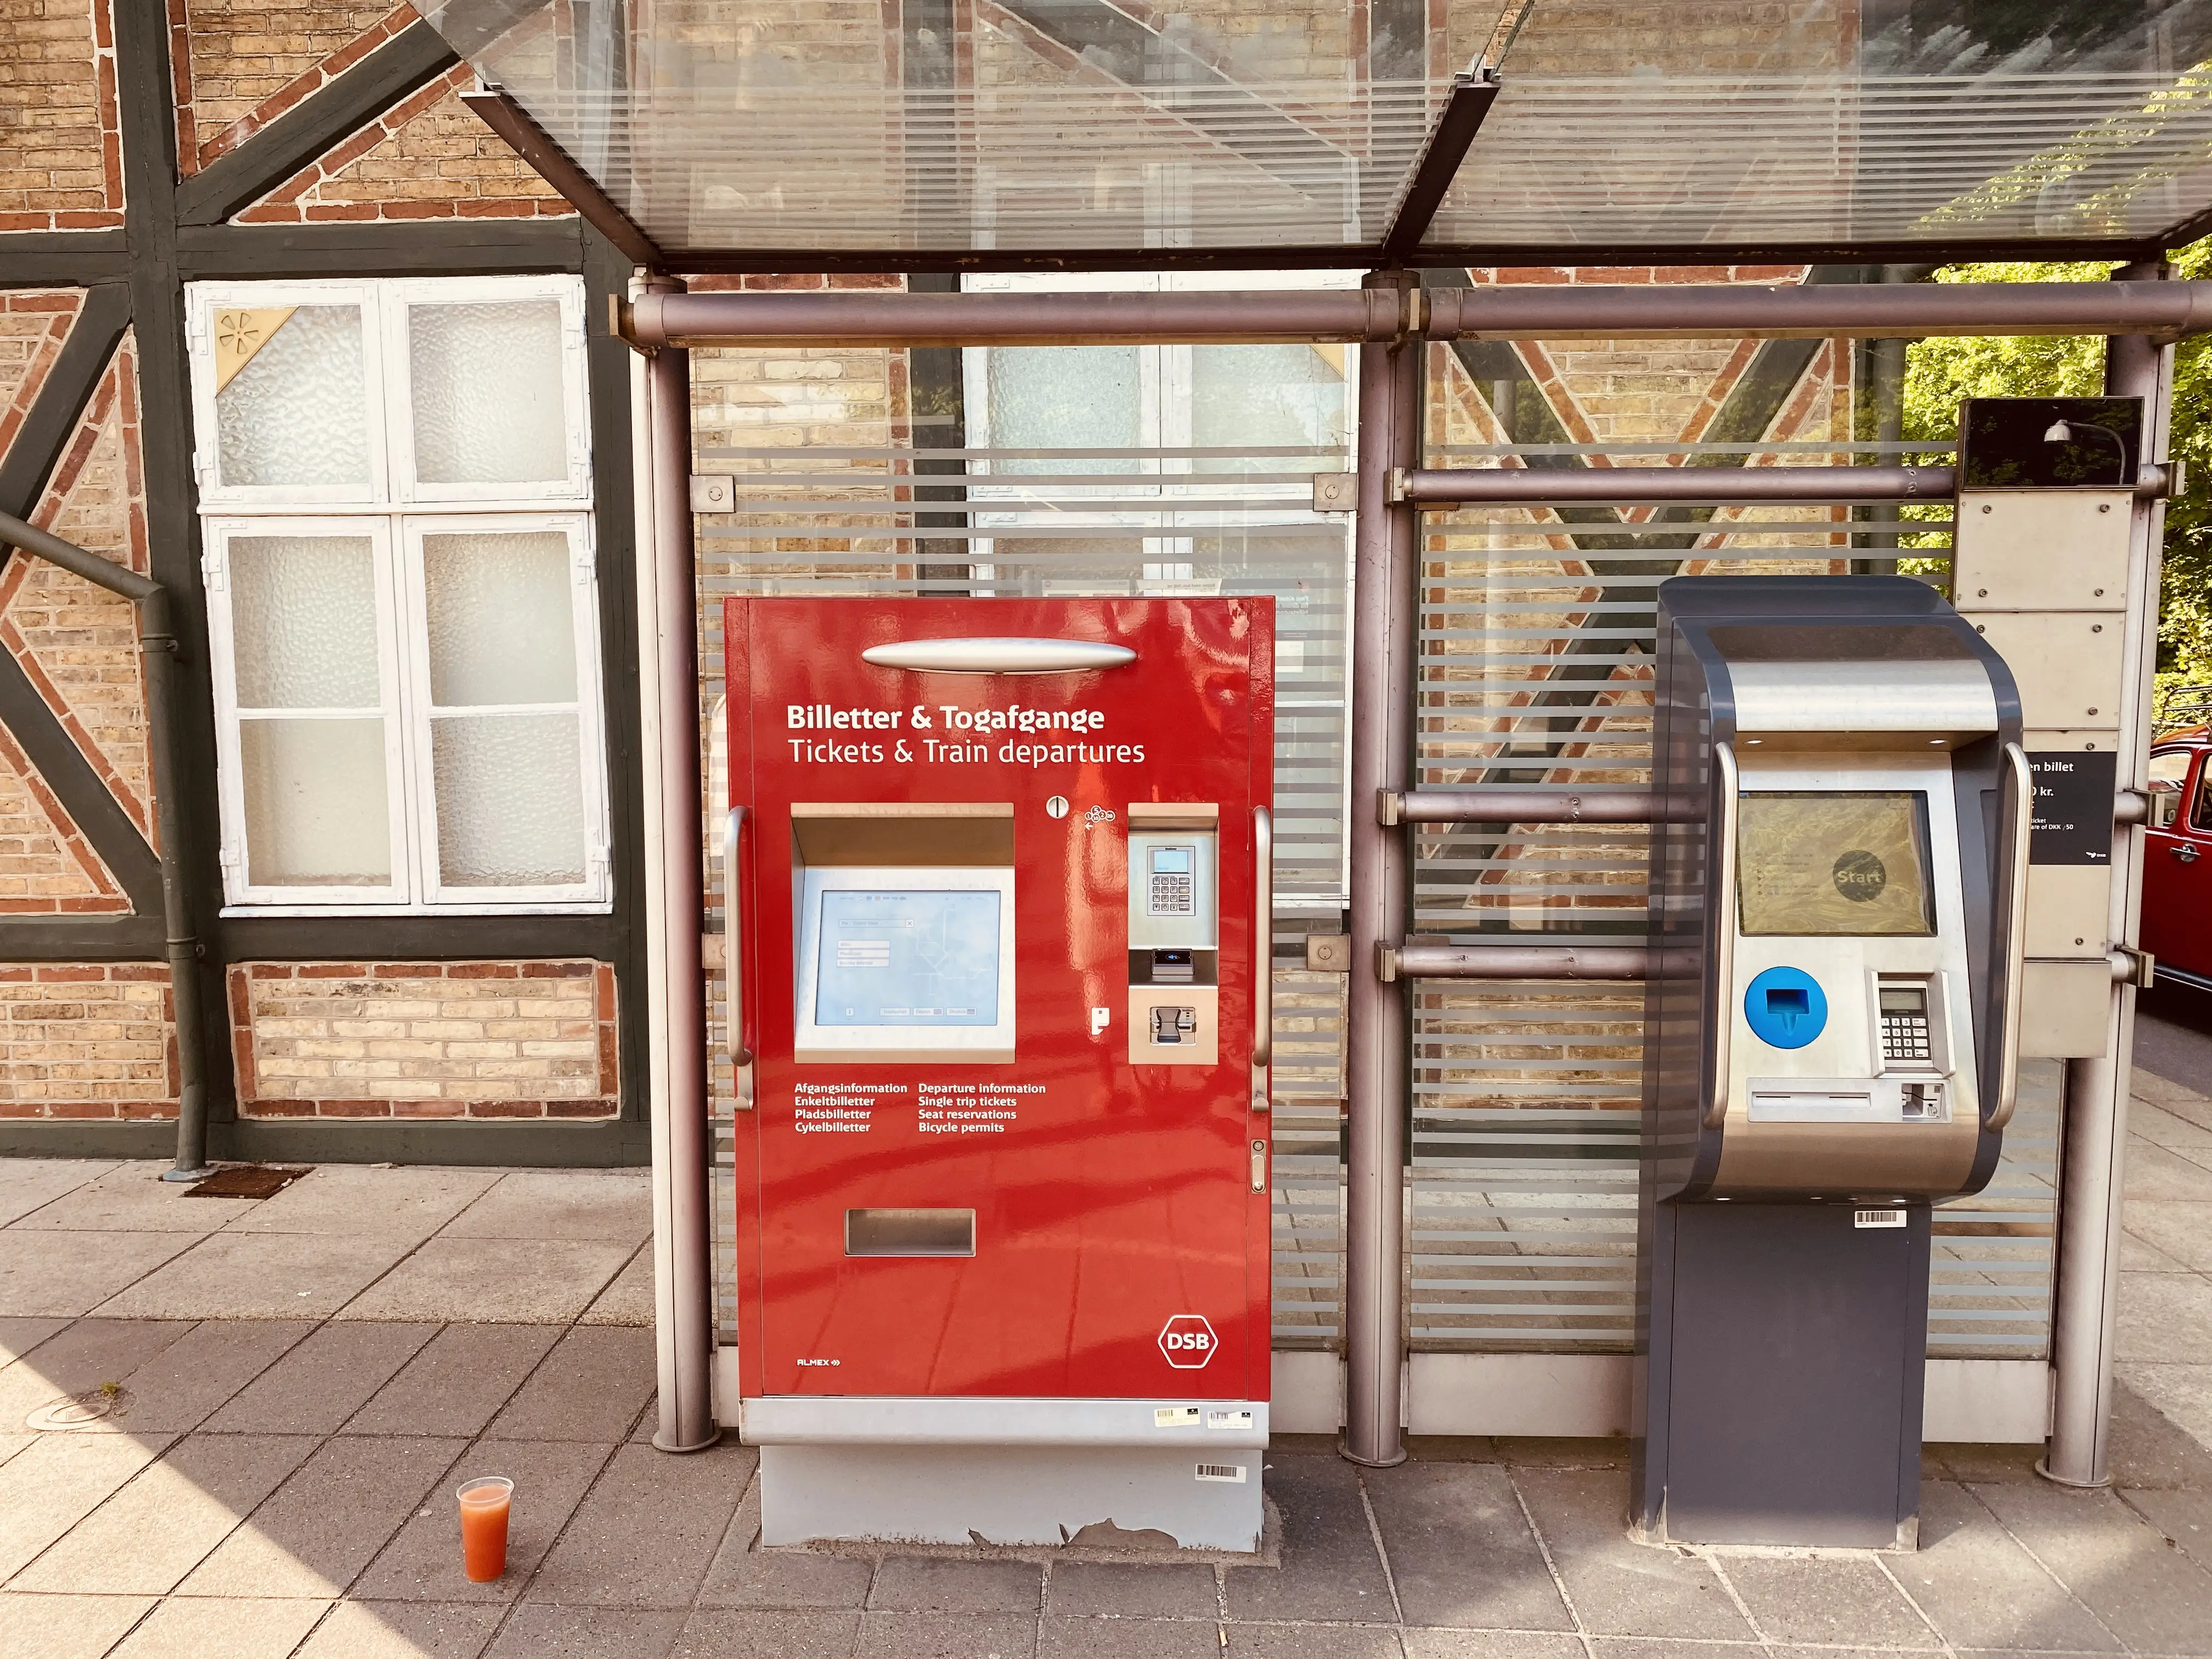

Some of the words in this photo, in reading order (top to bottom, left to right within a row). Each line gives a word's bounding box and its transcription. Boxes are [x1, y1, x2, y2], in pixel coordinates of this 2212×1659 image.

[788, 705, 902, 729] Billetter
[911, 706, 933, 729] &
[939, 705, 1104, 734] Togafgange
[788, 739, 884, 763] Tickets
[894, 740, 913, 763] &
[923, 739, 988, 763] Train
[998, 739, 1145, 769] departures
[2044, 761, 2074, 772] billet
[2040, 786, 2054, 796] kr.
[1838, 870, 1882, 883] Start
[794, 1083, 907, 1096] Afgangsinformation
[919, 1083, 975, 1096] Departure
[979, 1083, 1046, 1093] information
[795, 1096, 876, 1106] Enkeltbilletter
[918, 1096, 953, 1108] Single
[956, 1096, 977, 1108] trip
[979, 1096, 1017, 1106] tickets
[795, 1109, 871, 1119] Pladsbilletter
[918, 1109, 944, 1119] Seat
[946, 1109, 1017, 1119] reservations
[795, 1122, 871, 1135] Cykelbilletter
[919, 1122, 958, 1135] Bicycle
[961, 1122, 1005, 1135] permits
[1167, 1333, 1210, 1350] DSB
